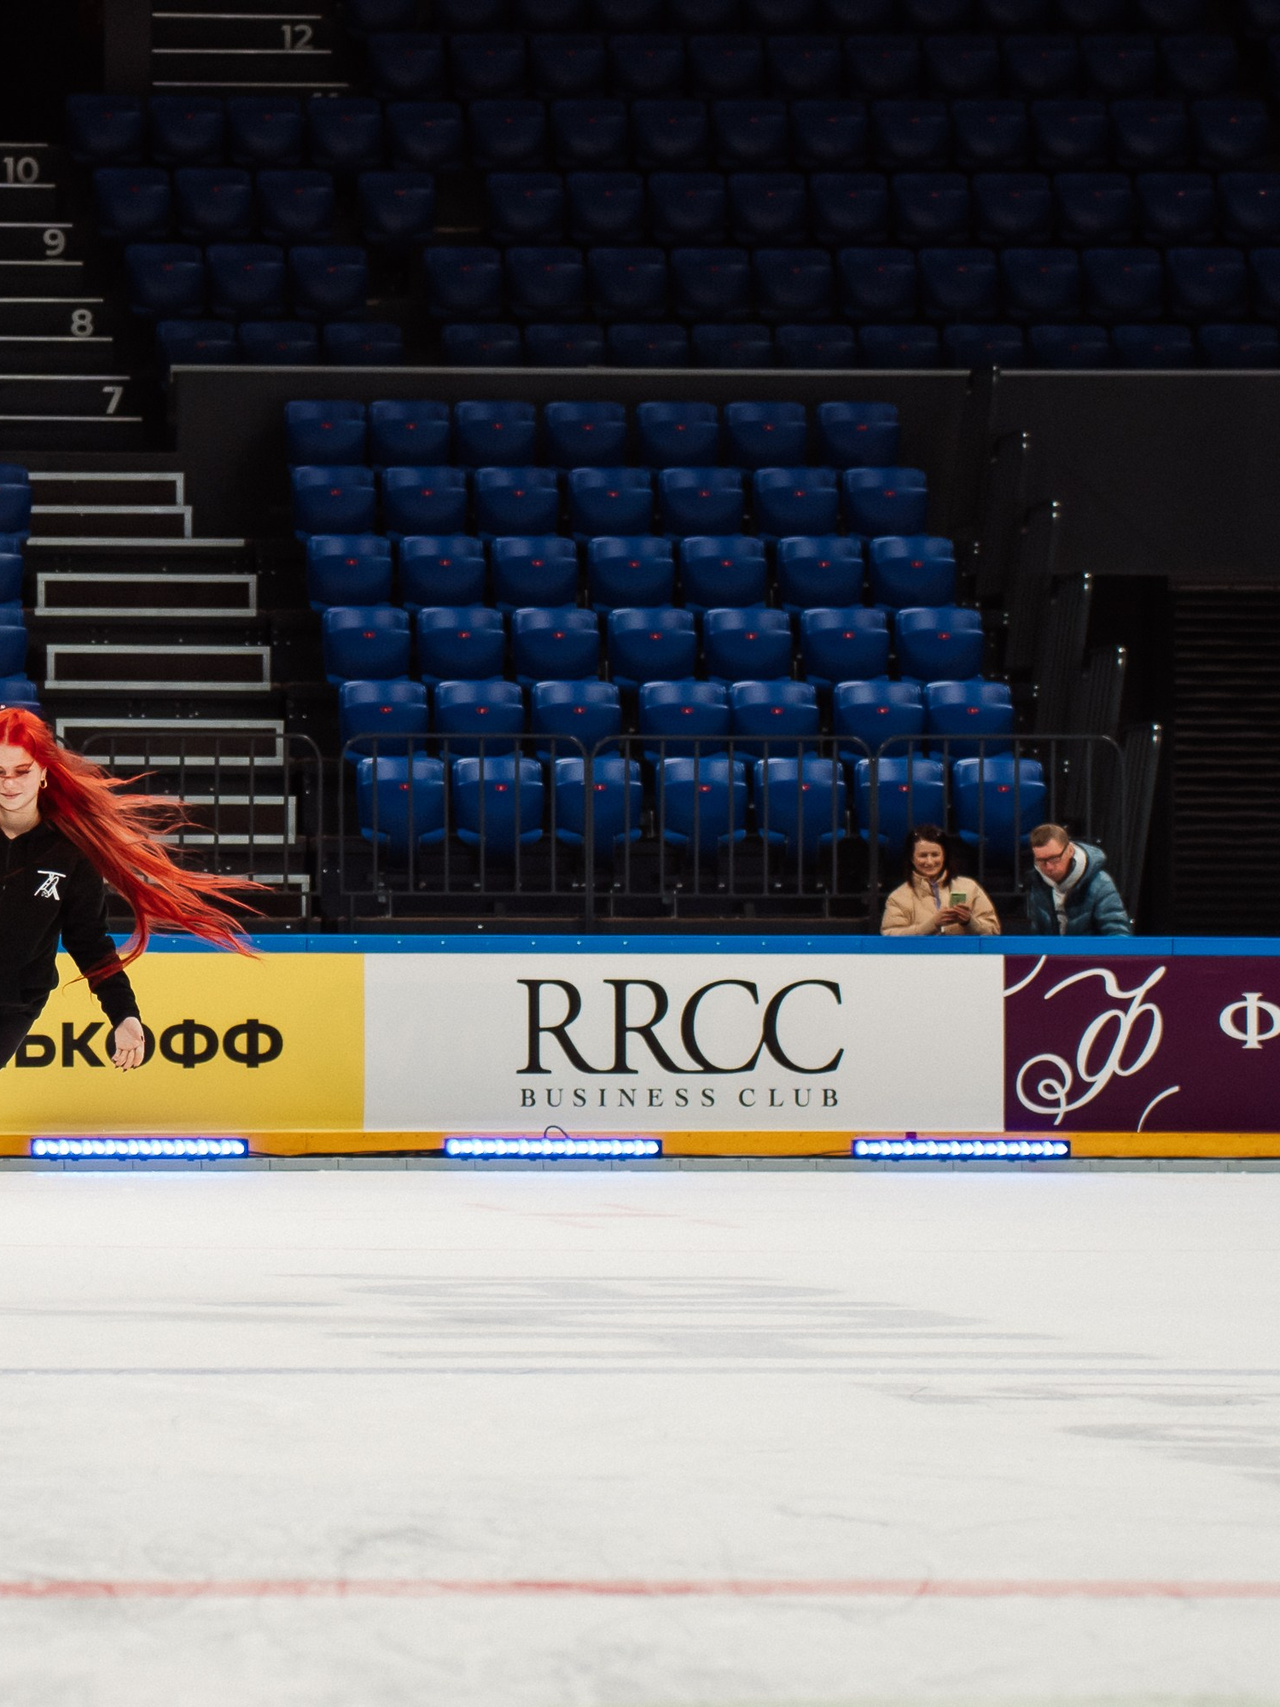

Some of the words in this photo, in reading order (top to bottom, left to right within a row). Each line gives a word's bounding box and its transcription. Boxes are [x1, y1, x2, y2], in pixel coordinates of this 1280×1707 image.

[281, 25, 313, 50] 12
[3, 157, 39, 184] 10
[43, 229, 65, 256] 9
[71, 309, 94, 337] 8
[103, 386, 124, 414] 7
[516, 979, 845, 1074] RRCC
[520, 1088, 715, 1107] BUSINESS
[738, 1088, 839, 1107] CLUB
